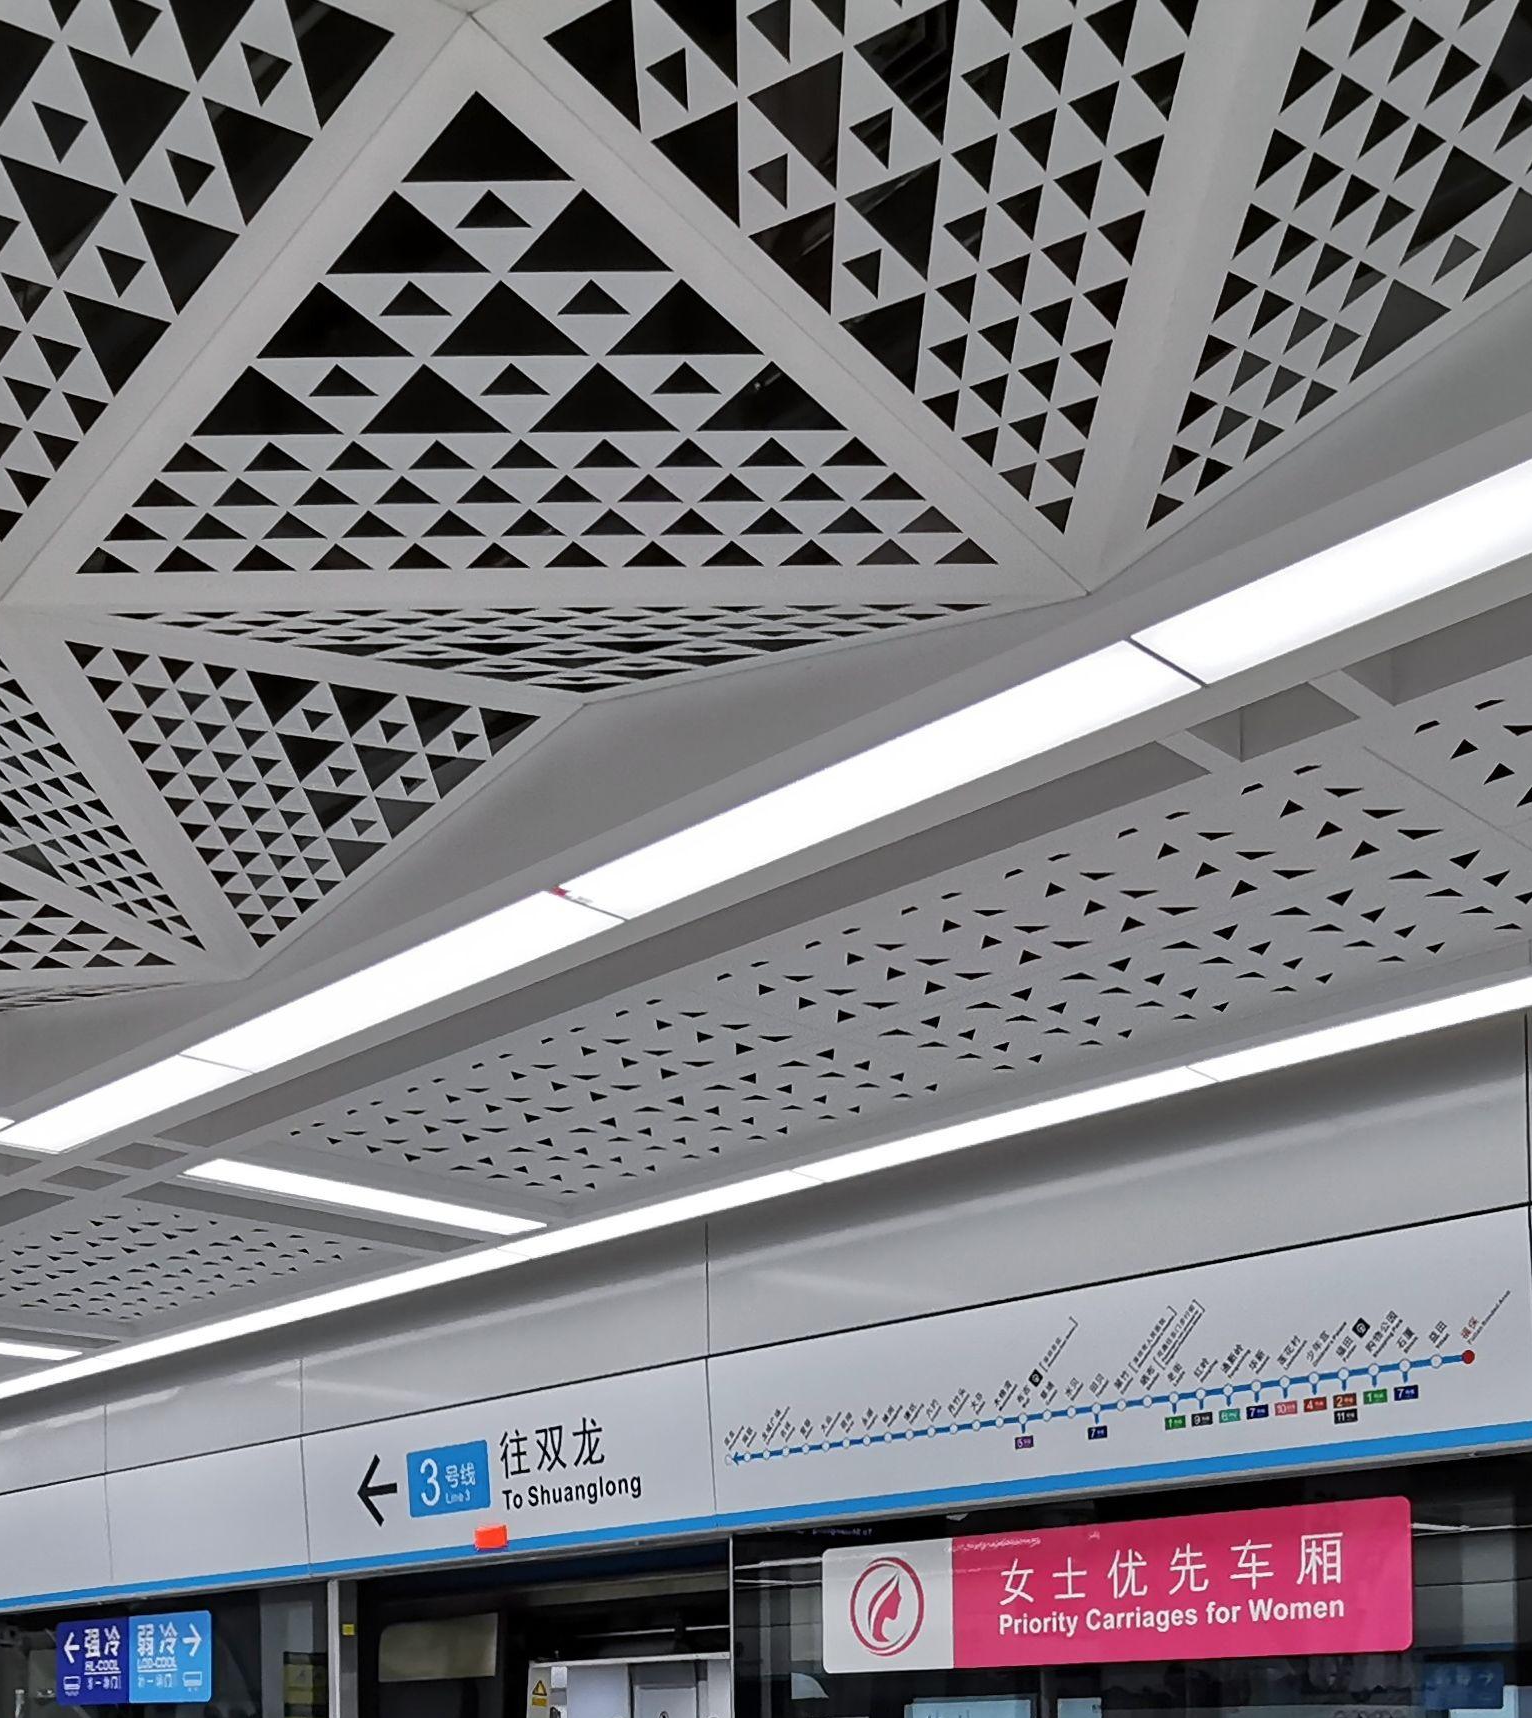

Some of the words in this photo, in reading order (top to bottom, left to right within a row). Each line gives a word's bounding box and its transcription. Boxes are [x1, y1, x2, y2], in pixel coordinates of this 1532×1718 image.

[499, 1416, 606, 1480] 往双龙
[502, 1489, 524, 1510] To
[527, 1476, 642, 1507] Shuanglong
[999, 1532, 1344, 1606] 女士优先车厢
[999, 1611, 1078, 1637] Priority
[1085, 1605, 1199, 1632] Carriages
[1206, 1601, 1242, 1625] for
[1246, 1597, 1345, 1623] Women
[84, 1626, 121, 1658] 强冷
[136, 1622, 178, 1657] 弱冷
